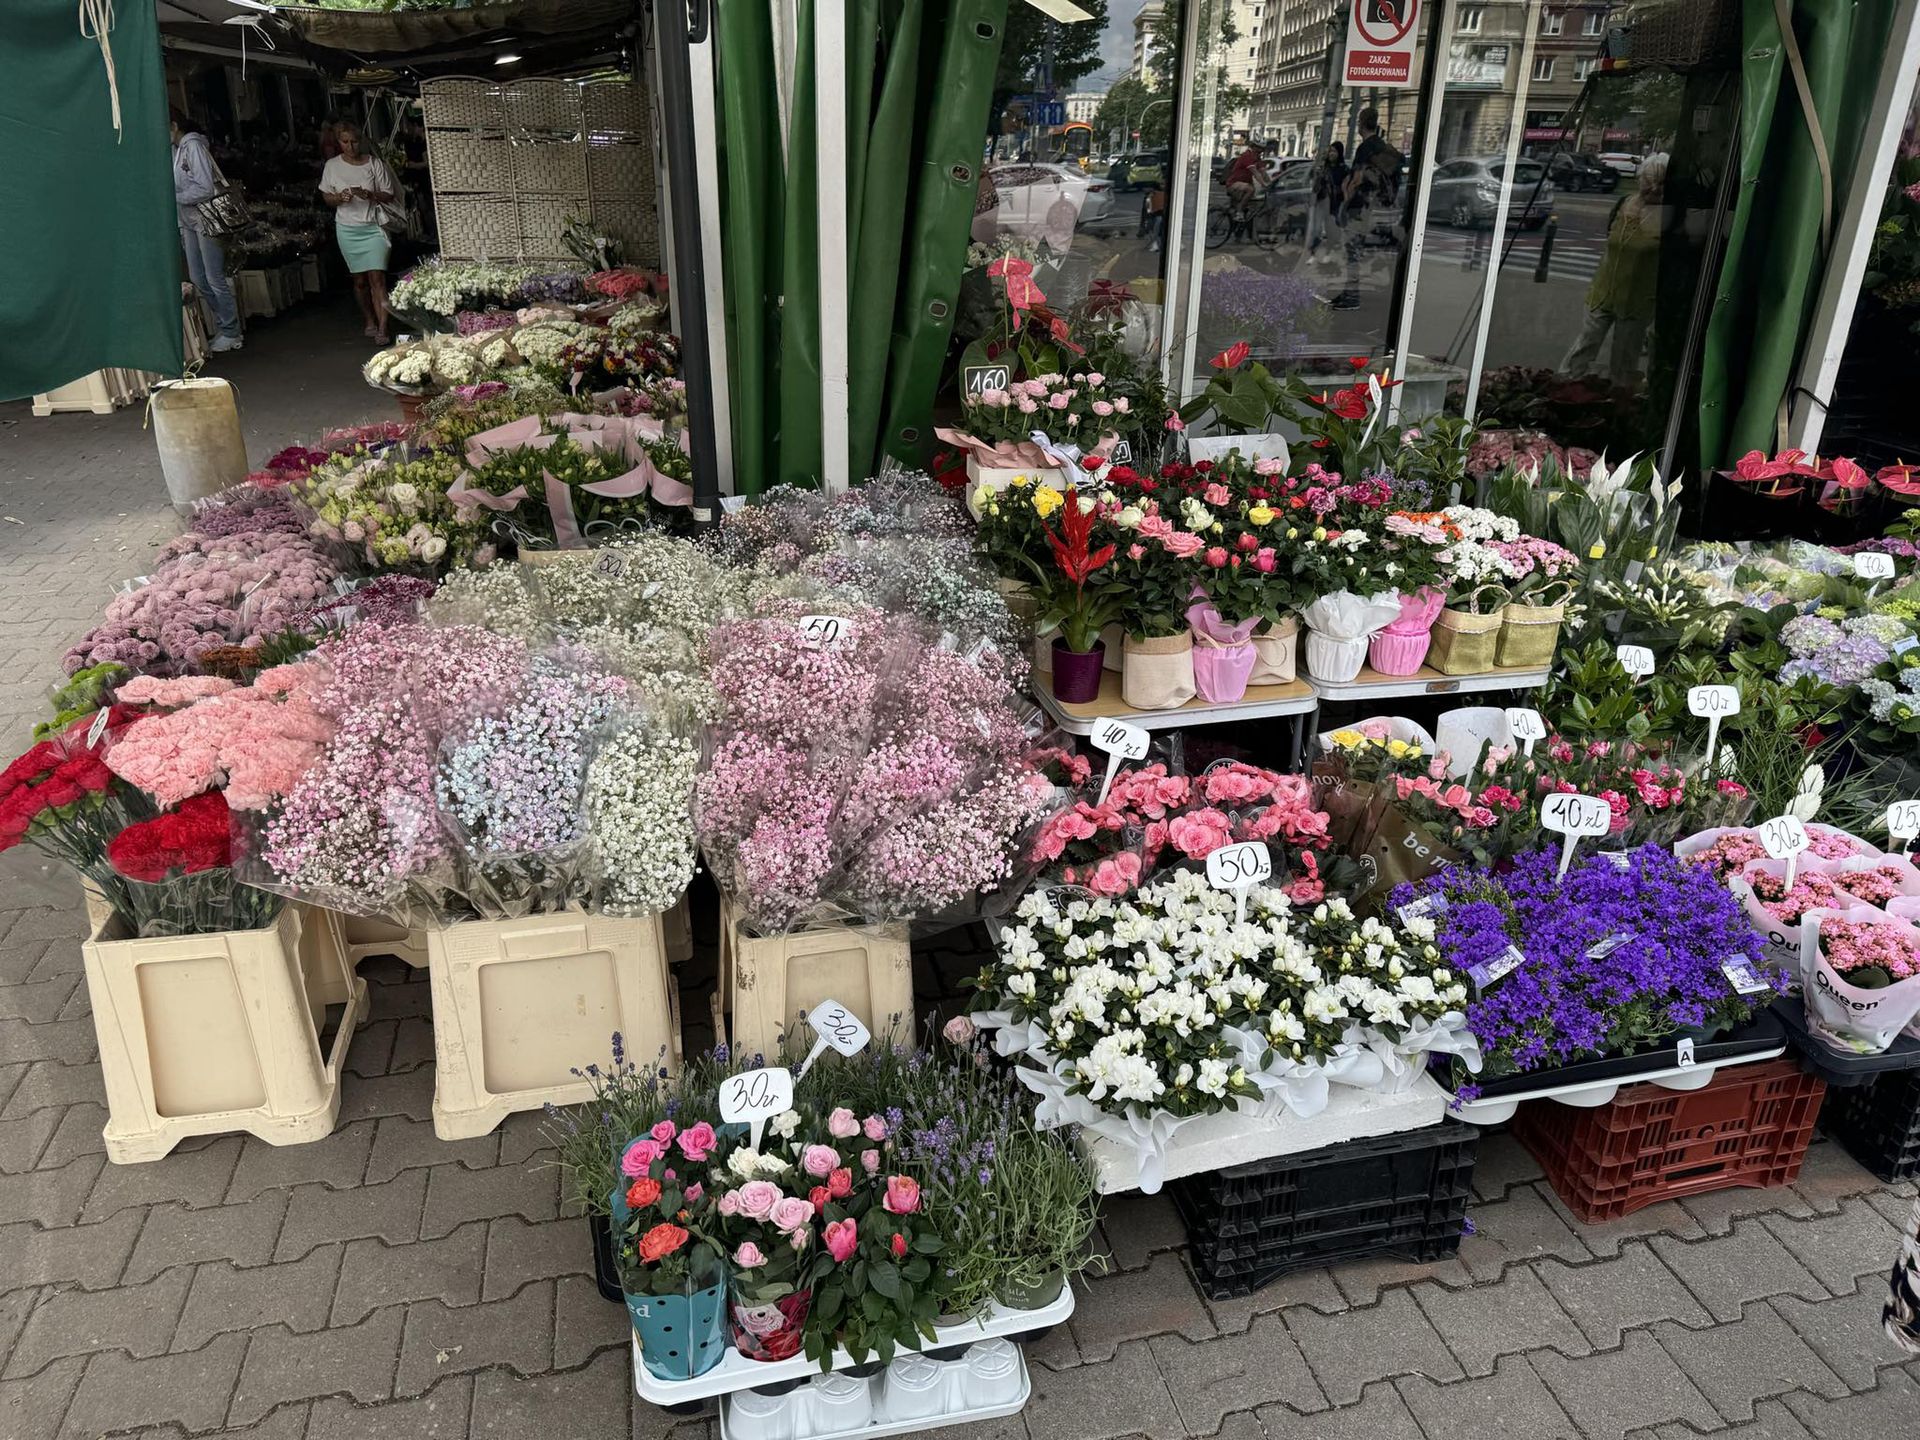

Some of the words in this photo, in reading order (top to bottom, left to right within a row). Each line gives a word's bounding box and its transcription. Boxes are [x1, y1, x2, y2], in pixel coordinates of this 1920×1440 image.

[1368, 55, 1391, 64] ZAKAZ
[1349, 67, 1407, 77] FOTOGRAFOWANIA
[970, 369, 1006, 393] 160
[1403, 831, 1430, 858] be
[1768, 930, 1801, 952] Qu
[1816, 970, 1879, 1011] Queen
[1680, 1050, 1692, 1063] A
